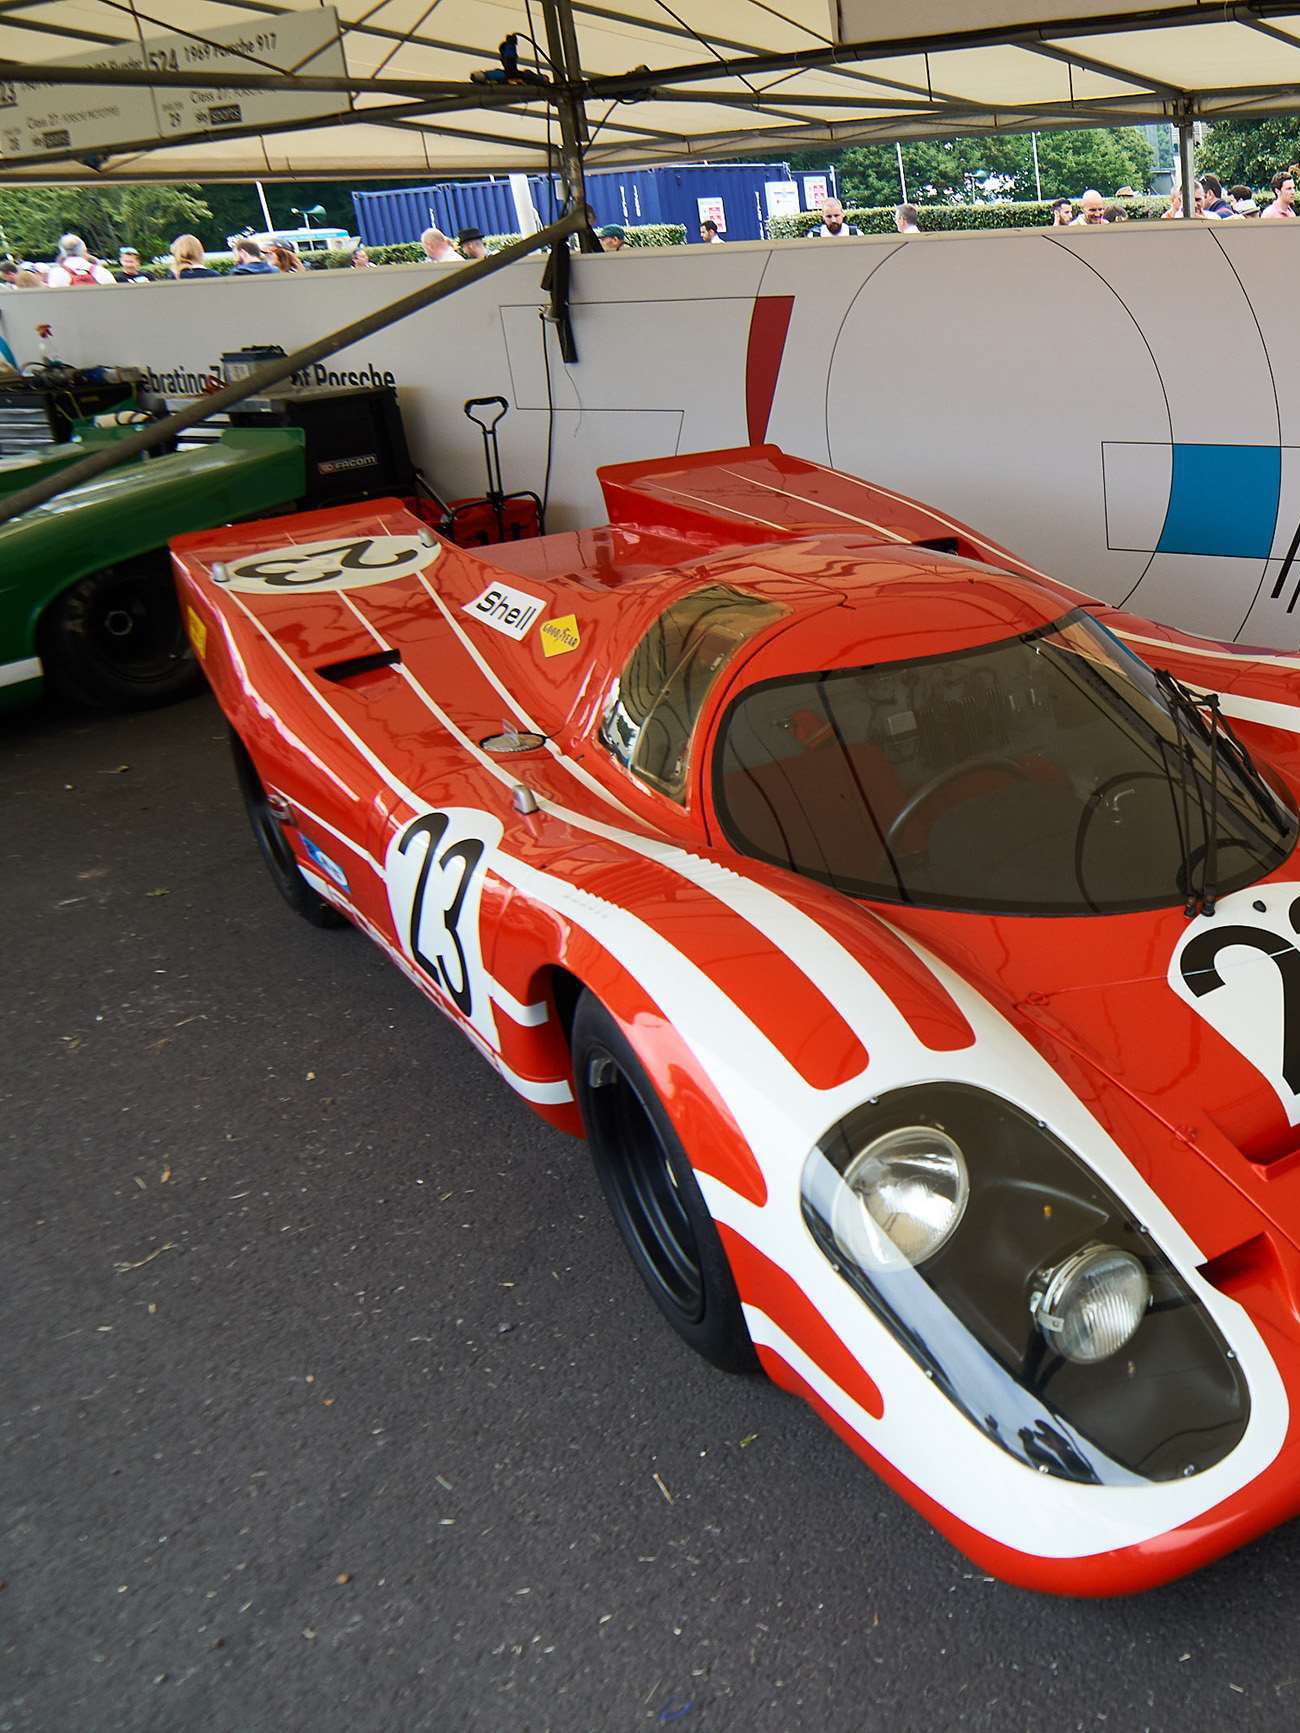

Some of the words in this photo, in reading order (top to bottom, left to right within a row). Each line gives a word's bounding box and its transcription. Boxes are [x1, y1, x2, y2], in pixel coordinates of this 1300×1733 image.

[149, 47, 179, 72] 524
[184, 44, 211, 62] 1969
[256, 32, 277, 51] 917
[314, 362, 396, 388] Porsche
[234, 539, 418, 586] 23
[476, 591, 537, 631] Shell
[398, 811, 485, 1018] 23
